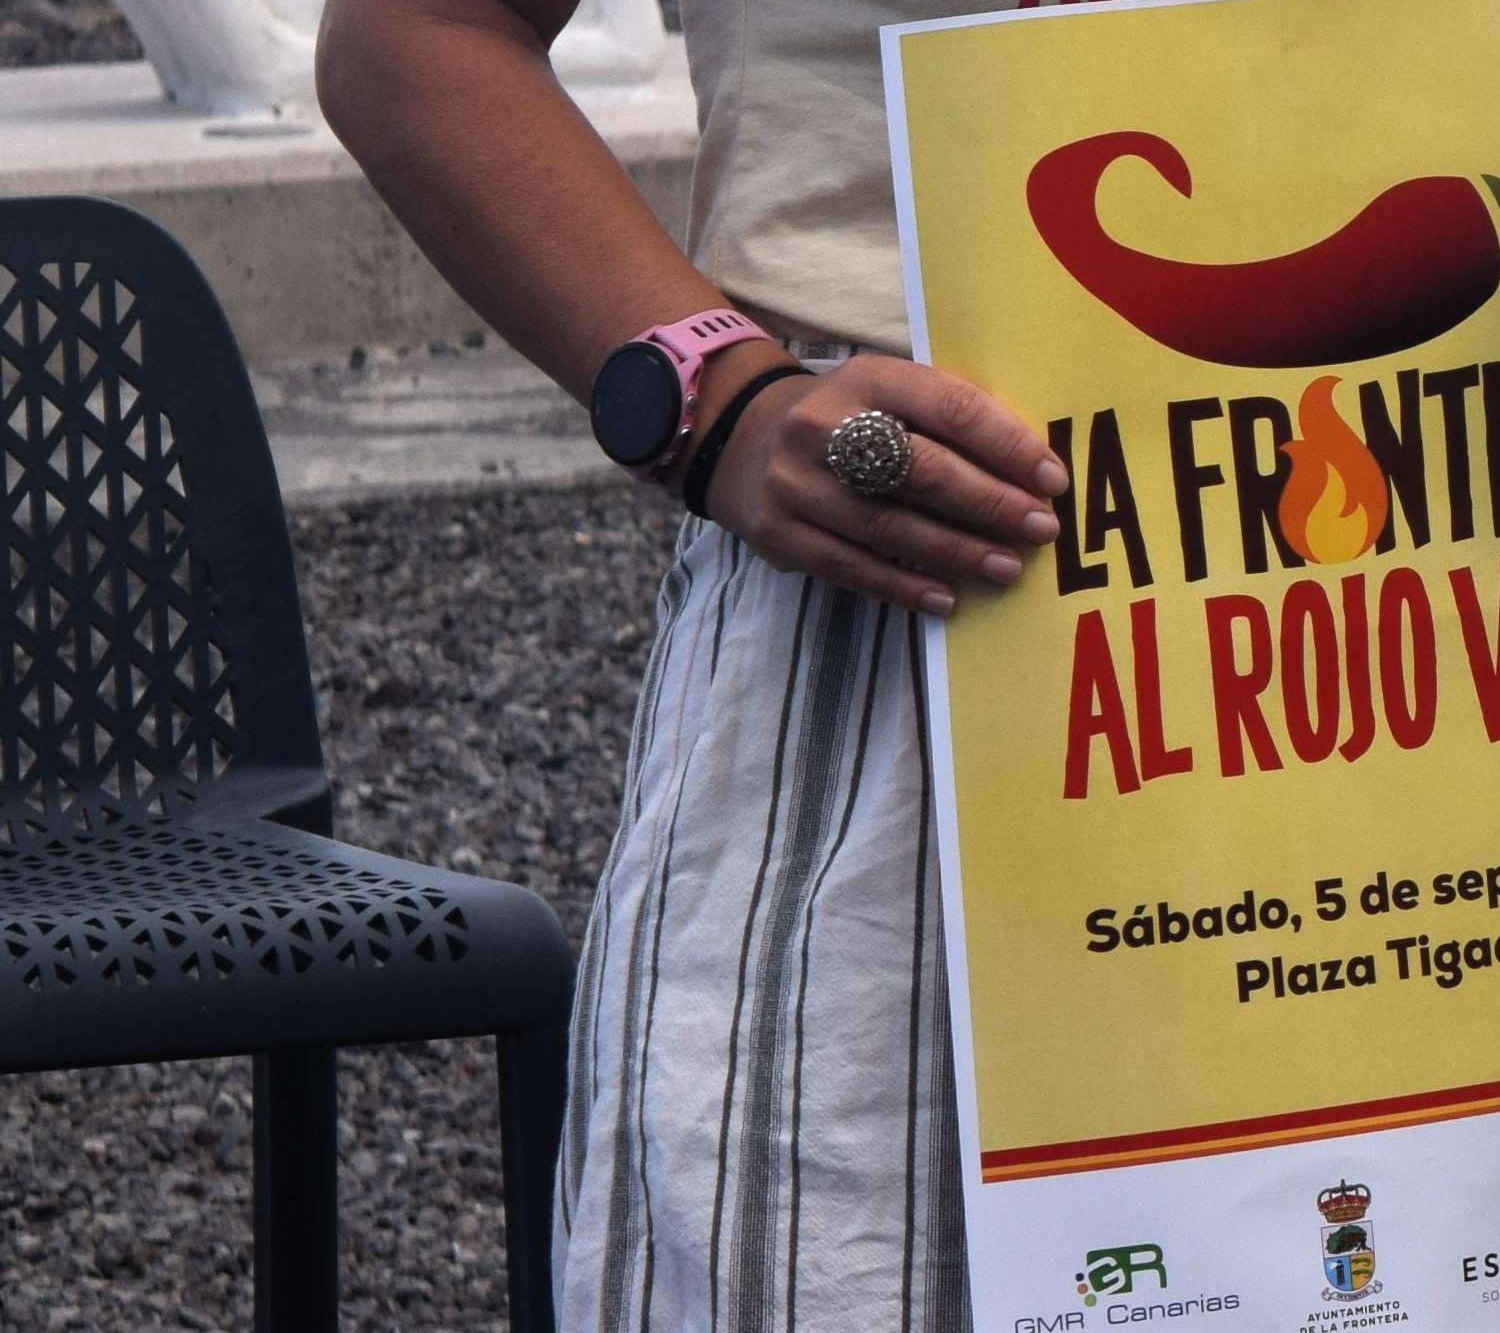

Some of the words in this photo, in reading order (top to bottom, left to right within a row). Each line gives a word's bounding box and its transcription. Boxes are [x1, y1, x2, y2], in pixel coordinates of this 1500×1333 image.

[1048, 408, 1153, 596] LA
[1063, 598, 1193, 800] AL
[1205, 567, 1438, 777] ROJO
[1085, 890, 1302, 953] Sábado,
[1315, 877, 1345, 922] 5
[1360, 866, 1420, 915] de
[1237, 955, 1376, 1003] Plaza
[1014, 1311, 1085, 1333] GMR
[1106, 1293, 1240, 1326] Canarias
[1307, 1300, 1401, 1322] AYUNTAMIENTO
[1321, 1323, 1338, 1333] LA
[1343, 1312, 1409, 1330] FRONTERA
